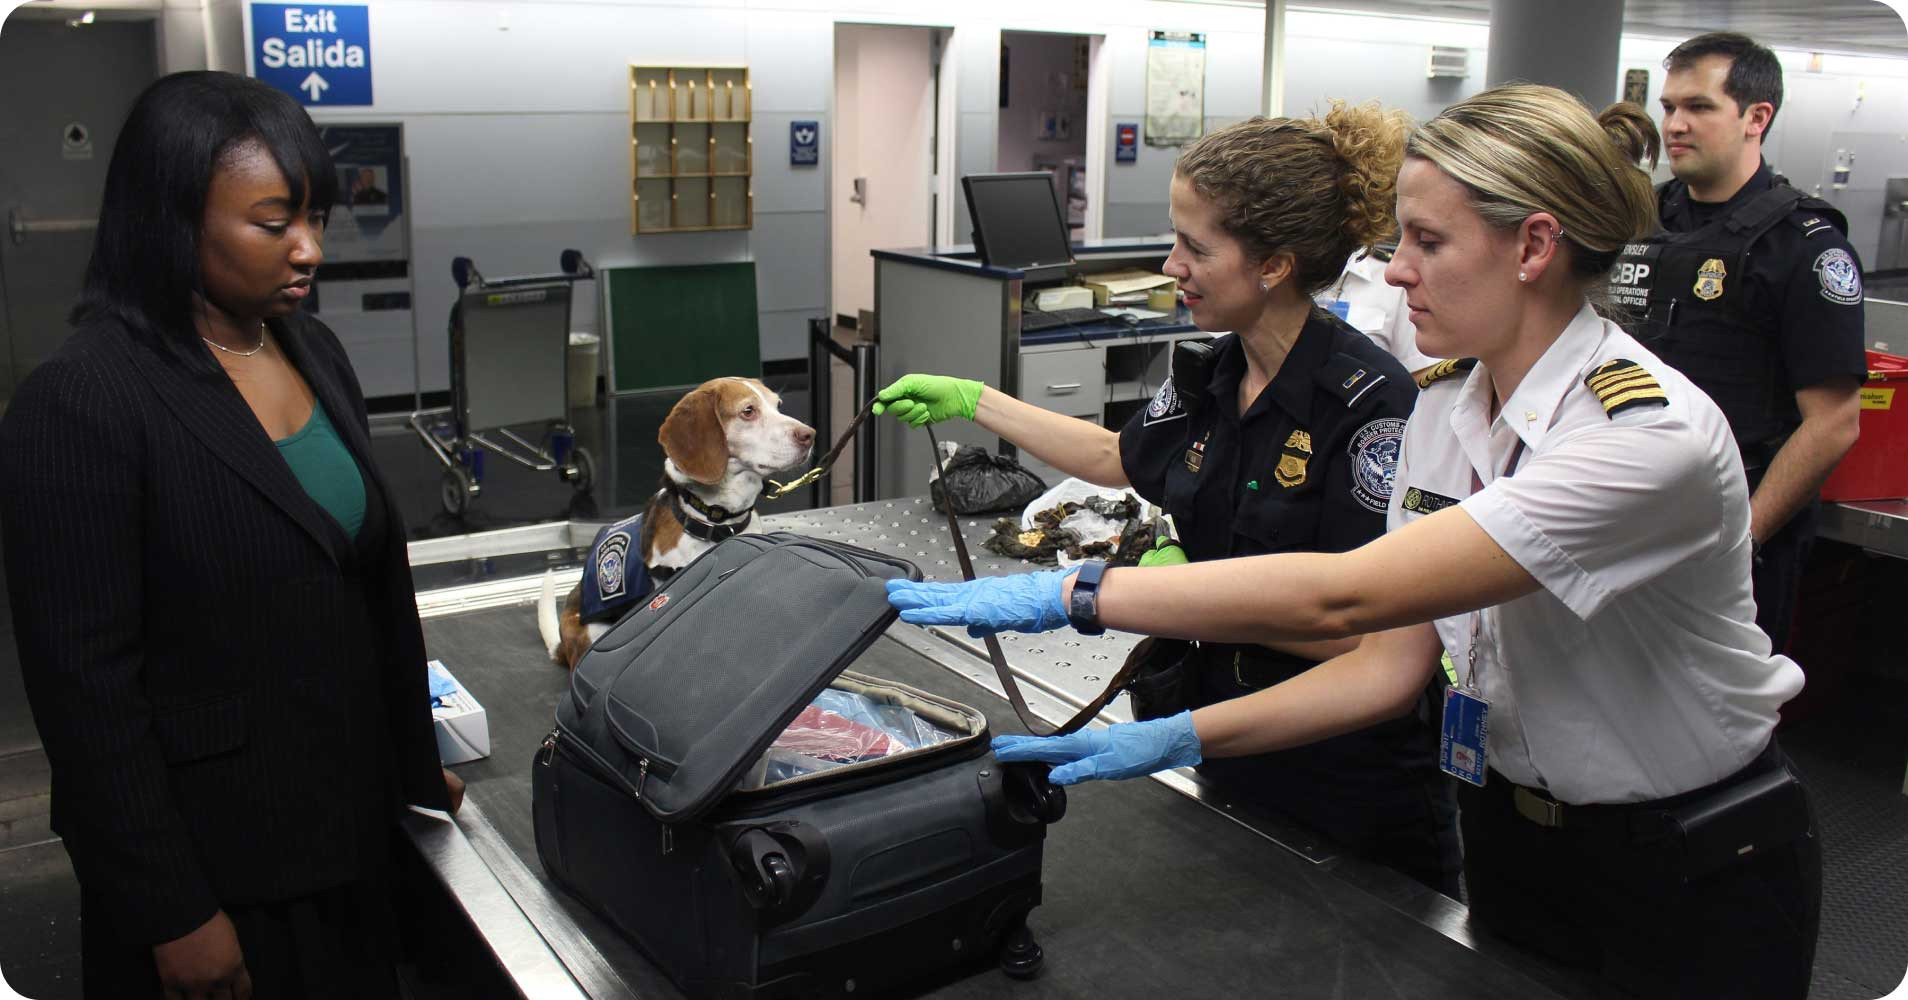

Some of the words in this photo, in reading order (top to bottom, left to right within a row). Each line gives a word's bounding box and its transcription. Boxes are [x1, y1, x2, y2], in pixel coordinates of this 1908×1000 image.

[285, 8, 337, 33] Exit
[263, 37, 364, 68] Salida
[1617, 287, 1648, 297] OPERATIONS
[1623, 296, 1647, 306] OFFICER
[1371, 421, 1400, 432] CUSTOMS
[1357, 430, 1378, 448] BORDER
[1369, 499, 1387, 508] FIELD
